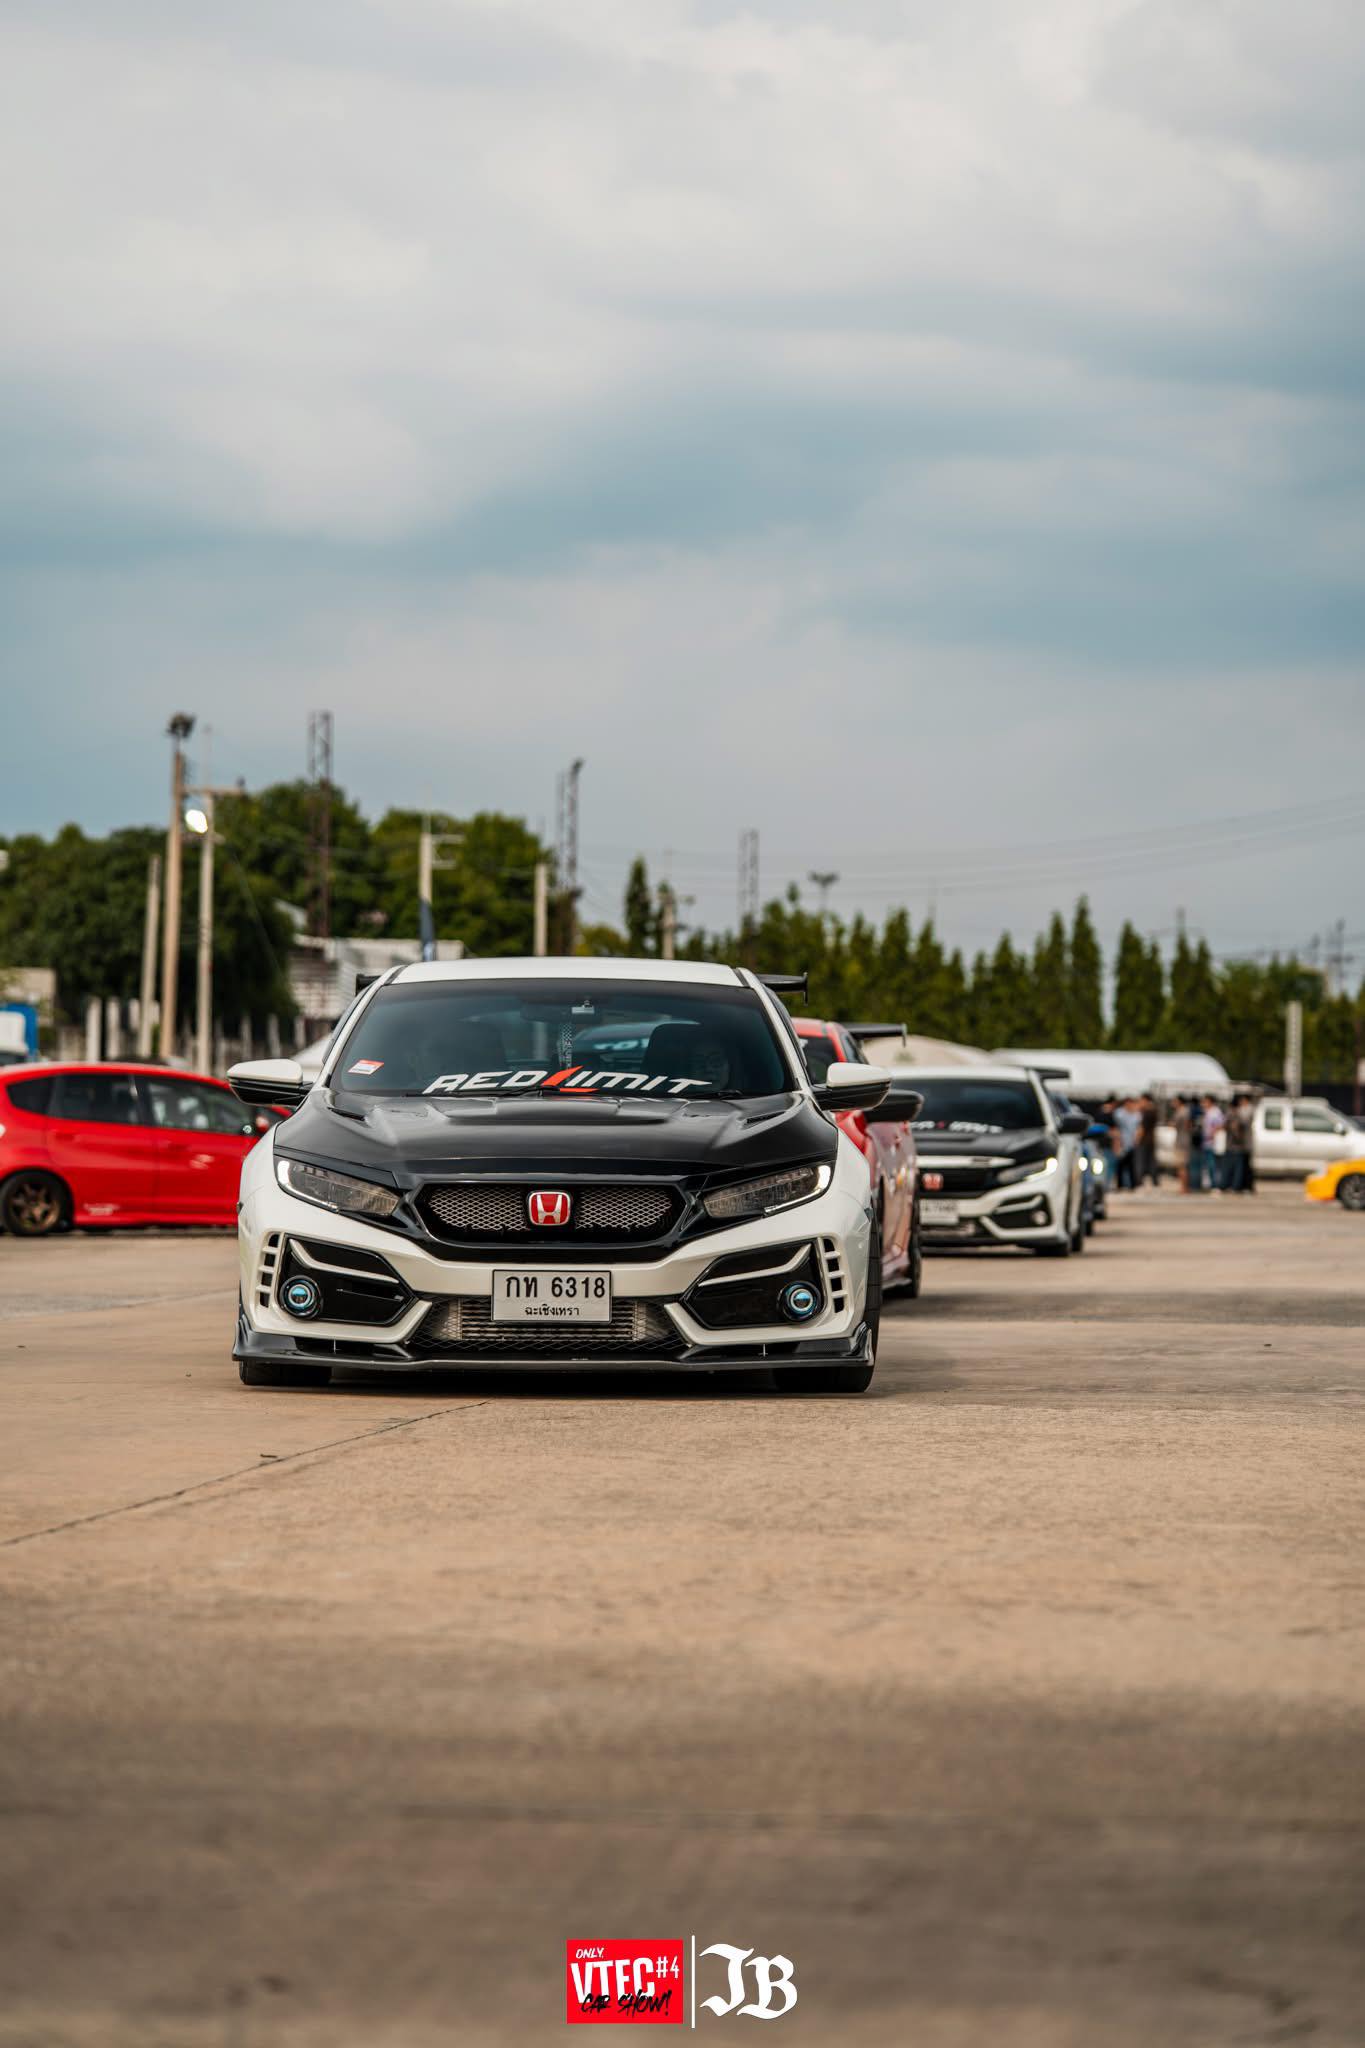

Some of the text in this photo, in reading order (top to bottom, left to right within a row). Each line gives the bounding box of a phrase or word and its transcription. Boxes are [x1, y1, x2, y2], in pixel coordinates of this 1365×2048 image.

[506, 1276, 606, 1299] กท 6318
[525, 1303, 580, 1316] ฉะเชิงเทรา
